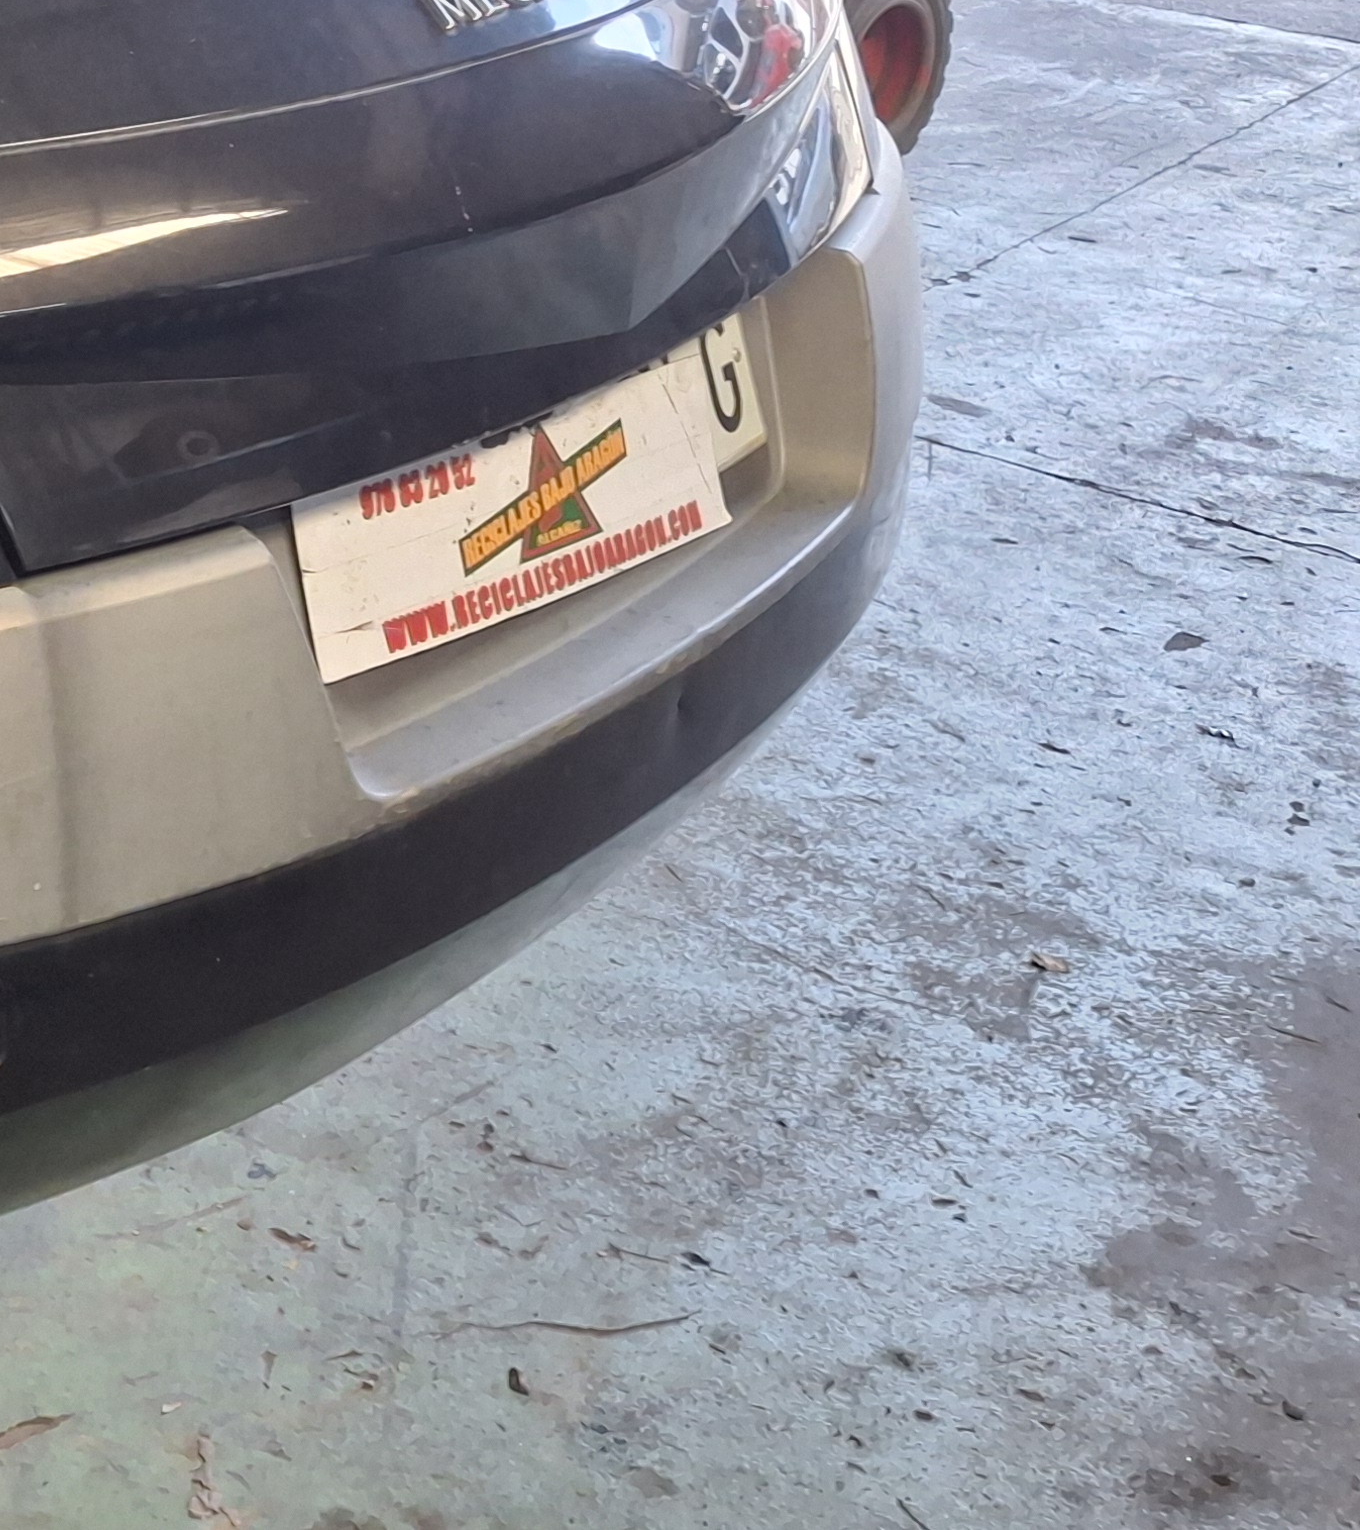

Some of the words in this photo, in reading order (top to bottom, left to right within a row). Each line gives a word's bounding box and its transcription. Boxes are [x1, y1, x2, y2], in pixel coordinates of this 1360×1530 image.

[449, 452, 476, 490] 52
[461, 490, 542, 570] RECICLAJES
[540, 465, 576, 512] BAJO
